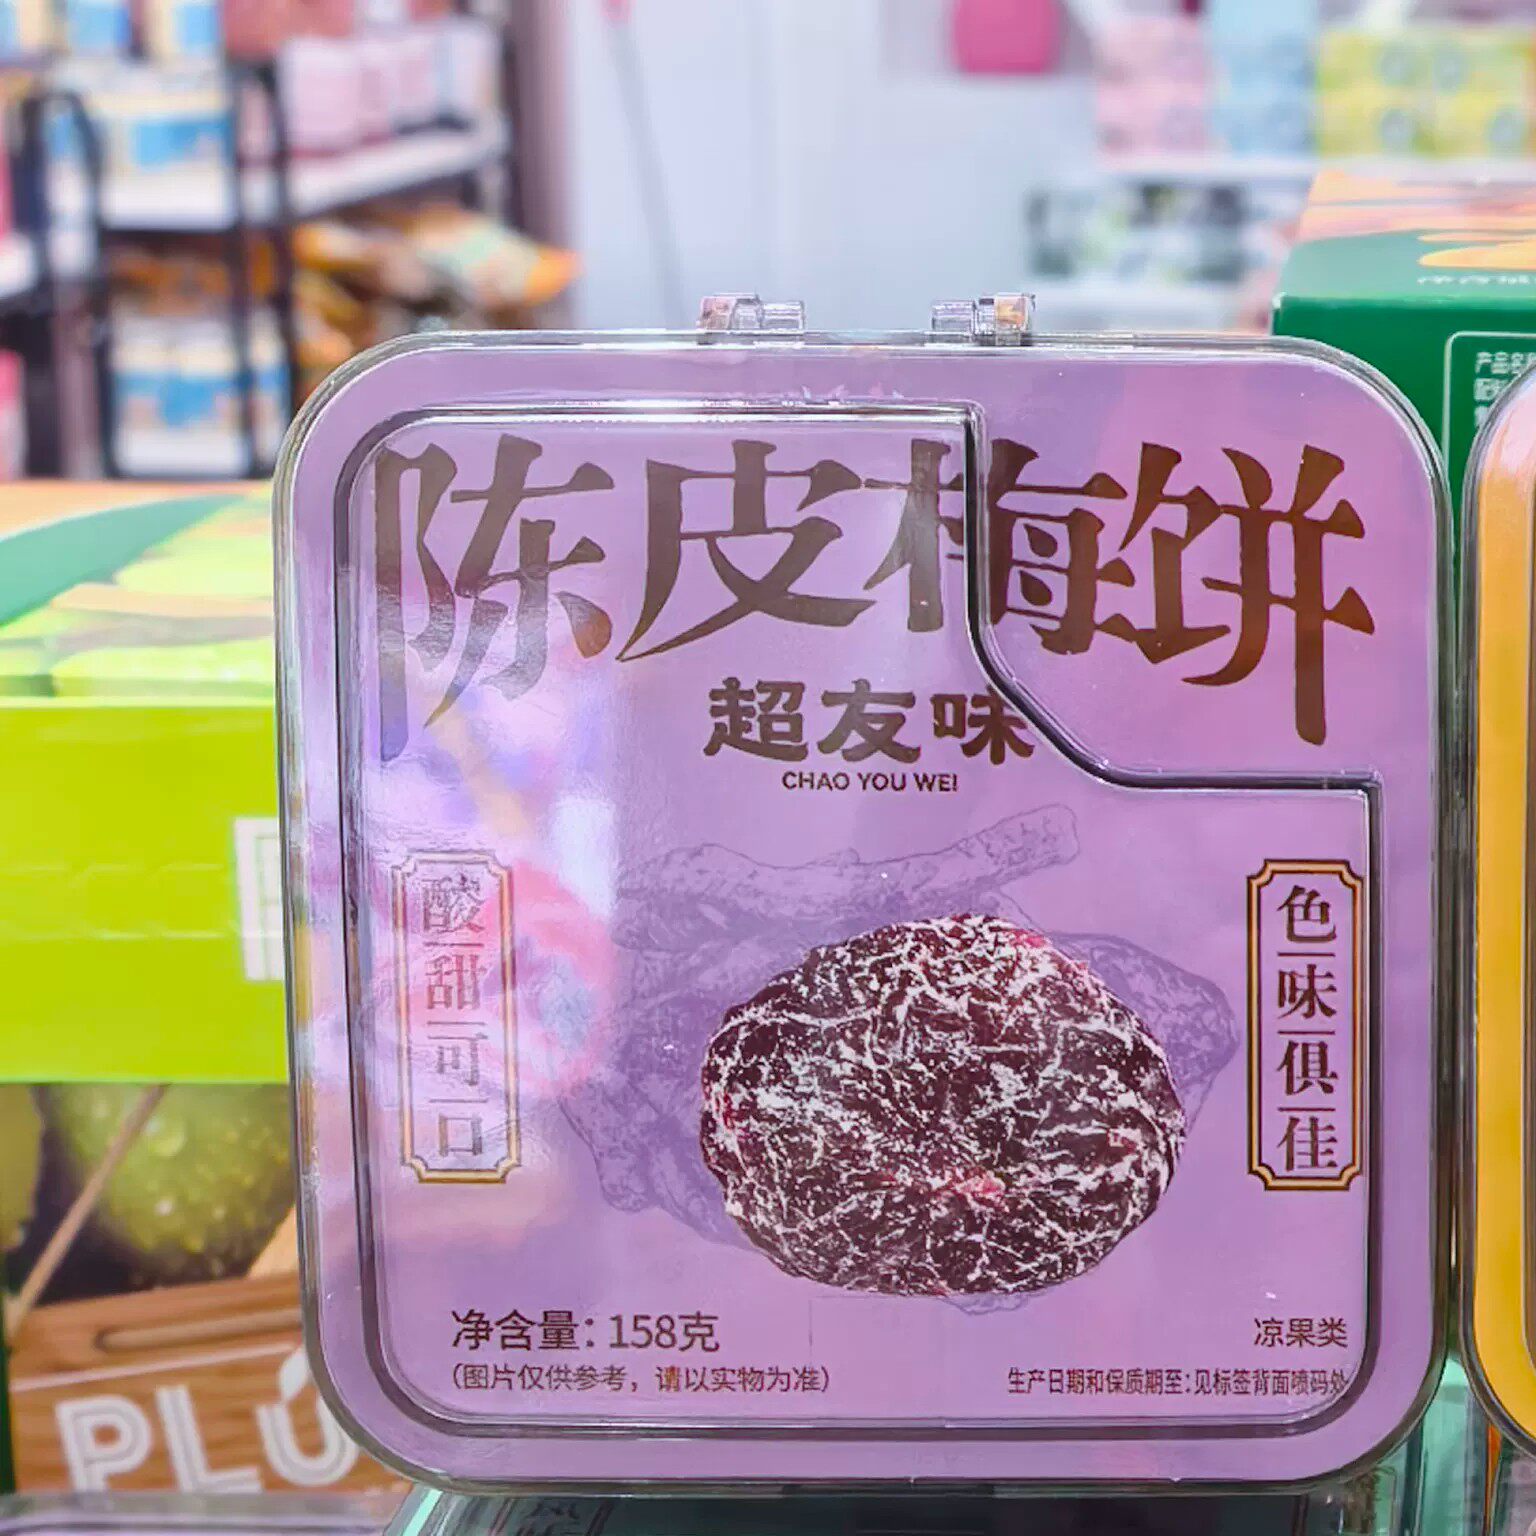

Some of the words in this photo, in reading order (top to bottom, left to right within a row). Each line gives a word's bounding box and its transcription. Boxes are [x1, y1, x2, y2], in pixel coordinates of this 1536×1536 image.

[374, 433, 1375, 763] 陈皮梅饼
[703, 677, 1036, 765] 超友味
[781, 771, 850, 793] CHAO
[857, 771, 907, 793] YOU
[914, 771, 958, 793] WEI
[420, 873, 490, 1158] 酸甜可口
[1276, 885, 1338, 1173] 色味俱佳
[450, 1309, 720, 1353] 净含量：158克
[1252, 1316, 1349, 1348] 凉果类
